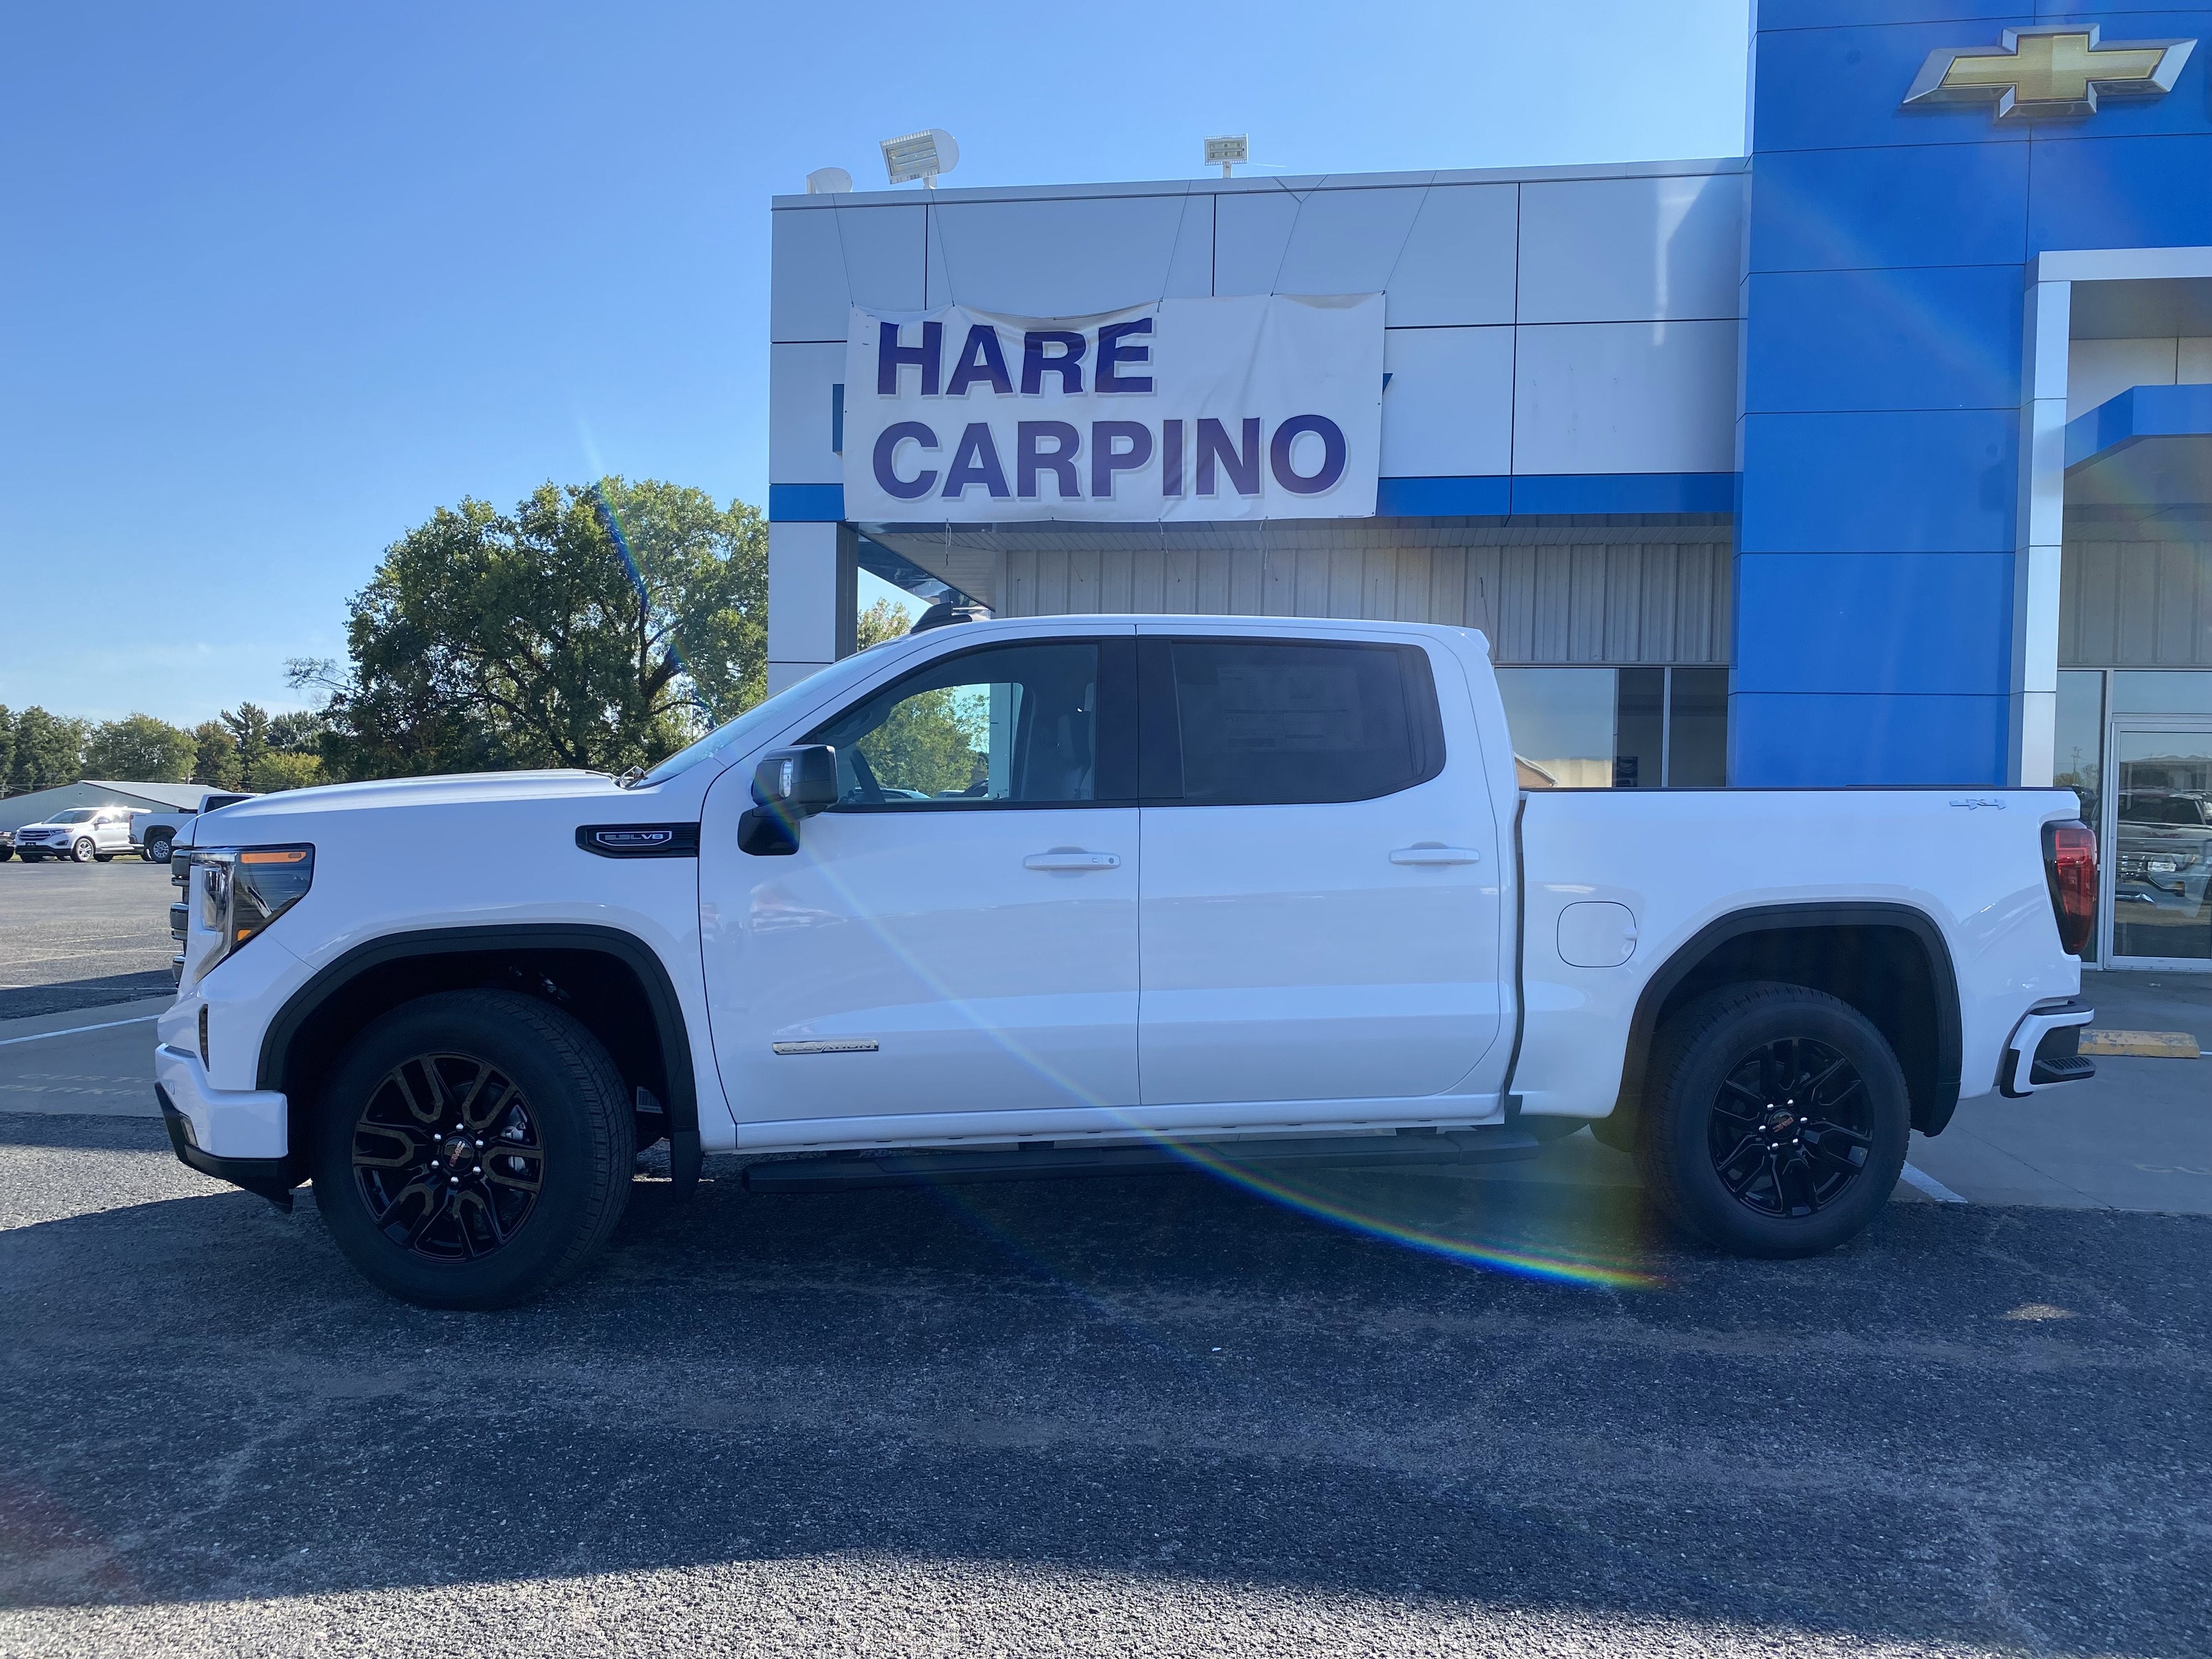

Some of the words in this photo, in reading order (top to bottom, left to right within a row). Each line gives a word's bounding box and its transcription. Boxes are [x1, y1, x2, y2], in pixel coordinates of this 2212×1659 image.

[876, 317, 1154, 396] HARE
[871, 413, 1348, 500] CARPINO
[449, 1141, 466, 1167] GMC
